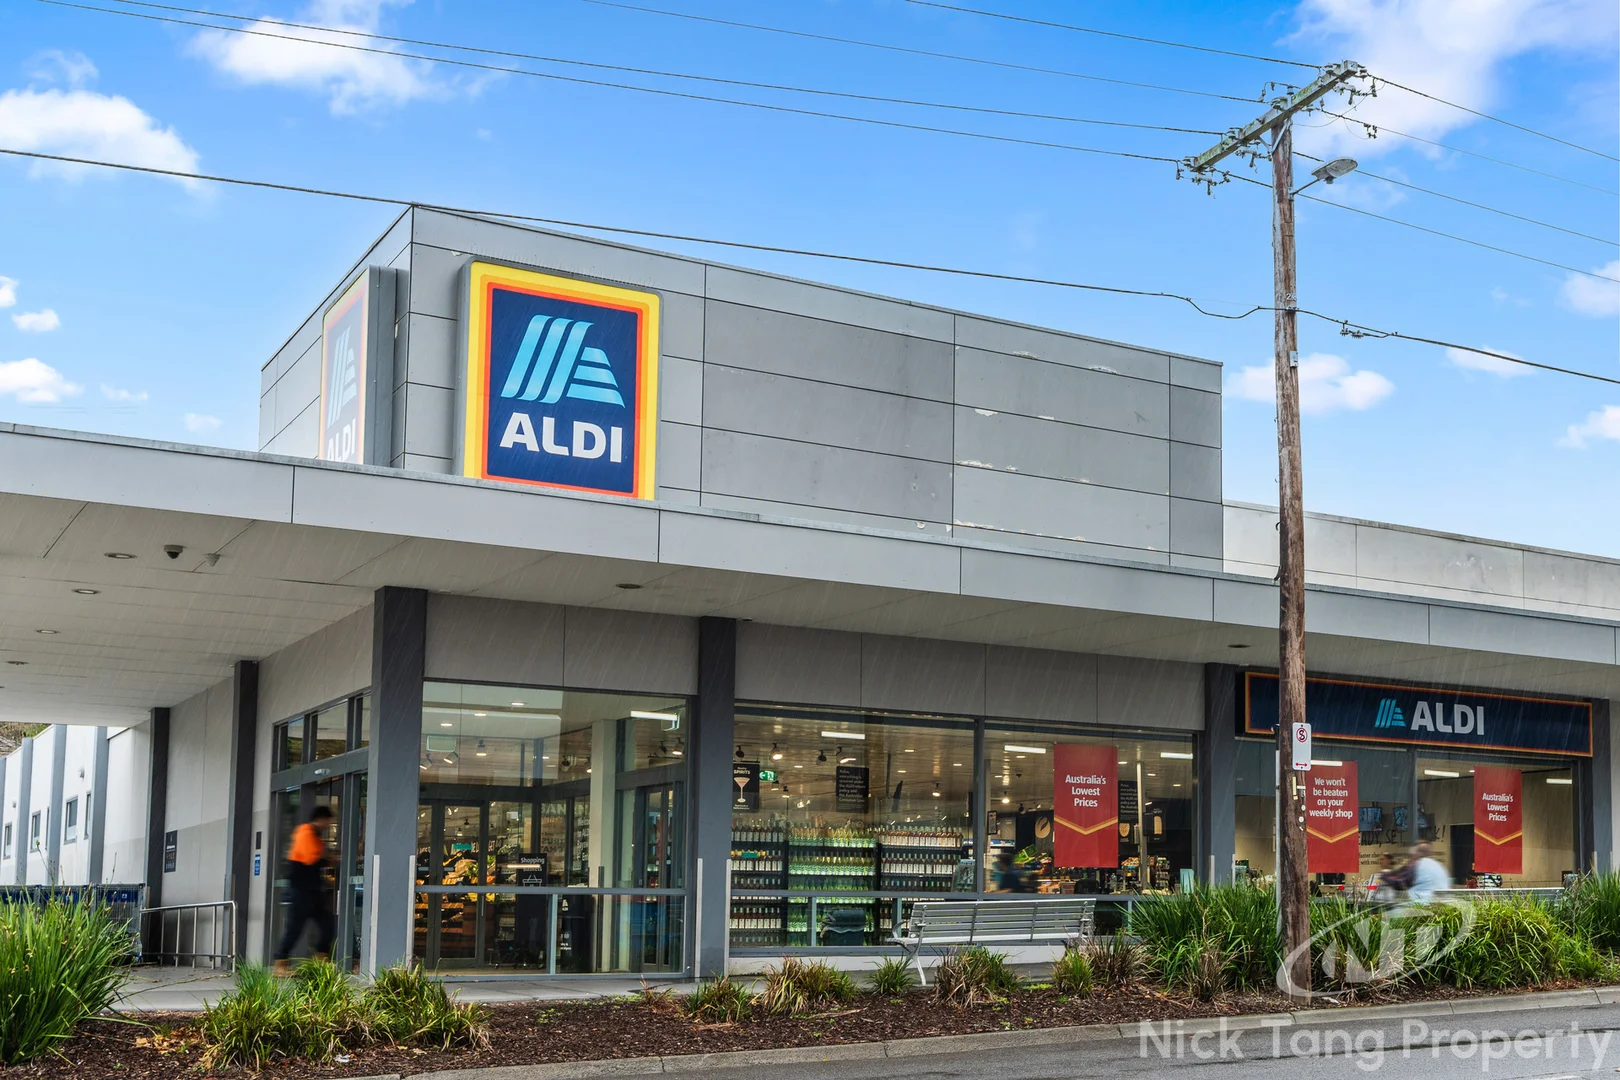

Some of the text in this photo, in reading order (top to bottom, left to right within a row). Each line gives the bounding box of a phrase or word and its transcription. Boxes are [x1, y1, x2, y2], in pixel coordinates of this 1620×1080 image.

[327, 417, 356, 461] ALDI
[500, 412, 623, 463] ALDI
[1410, 700, 1485, 736] ALDI
[1065, 774, 1106, 785] Australia's
[1314, 778, 1346, 786] We won't
[1071, 786, 1101, 796] Lowest
[1313, 787, 1348, 797] be beaten
[1482, 792, 1514, 802] Australia's
[1073, 797, 1098, 808] Prices
[1317, 798, 1344, 808] on your
[1487, 803, 1509, 812] Lowest
[1309, 809, 1353, 820] weekly shop
[1489, 812, 1507, 822] Prices
